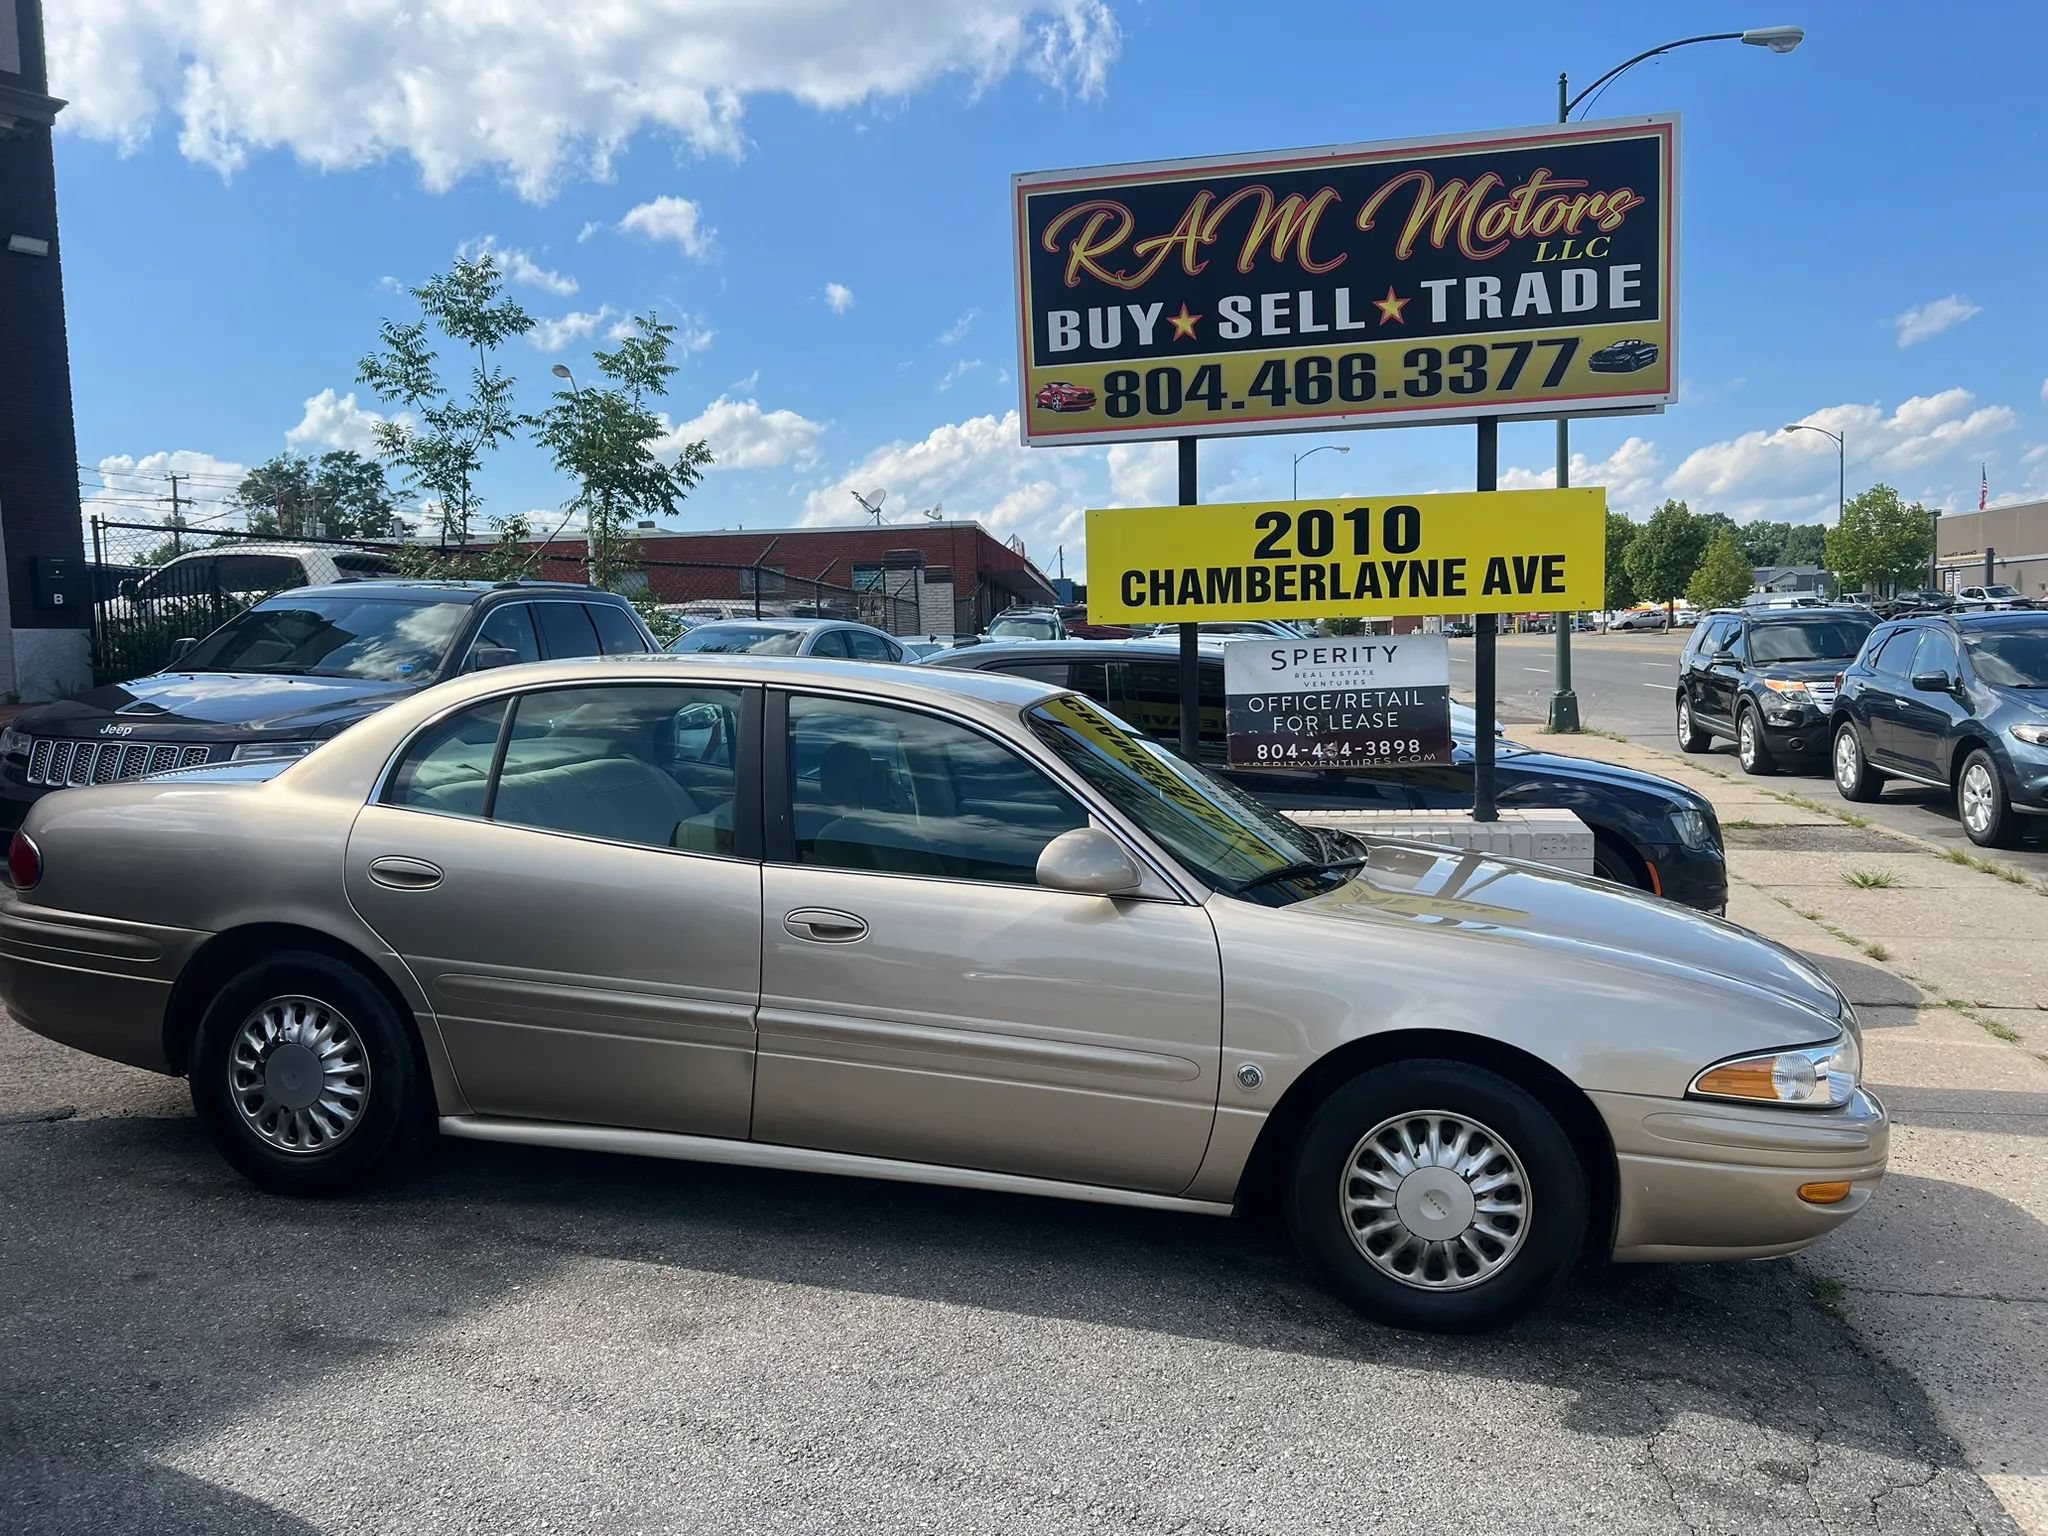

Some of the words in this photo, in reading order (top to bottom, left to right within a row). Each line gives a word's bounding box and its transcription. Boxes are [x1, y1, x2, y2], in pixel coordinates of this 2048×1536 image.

[1042, 184, 1348, 290] RAM
[1357, 167, 1645, 262] Motors
[1532, 236, 1611, 263] LLC
[1047, 302, 1164, 353] BUY
[1217, 287, 1366, 340] SELL
[1420, 264, 1642, 323] TRADE
[1104, 338, 1582, 418] 804.466.3377
[1254, 505, 1422, 560] 2010
[1120, 557, 1467, 608] CHAMBERLAYNE
[1482, 554, 1567, 596] AVE
[53, 593, 64, 605] B
[1270, 645, 1399, 672] SPERITY
[1303, 679, 1366, 688] VENTURES
[1331, 669, 1375, 678] ESTATE
[1248, 690, 1424, 713] OFFICE/RETAIL
[100, 723, 133, 737] Jeep
[1273, 715, 1320, 732] FOR
[1329, 711, 1399, 730] LEASE
